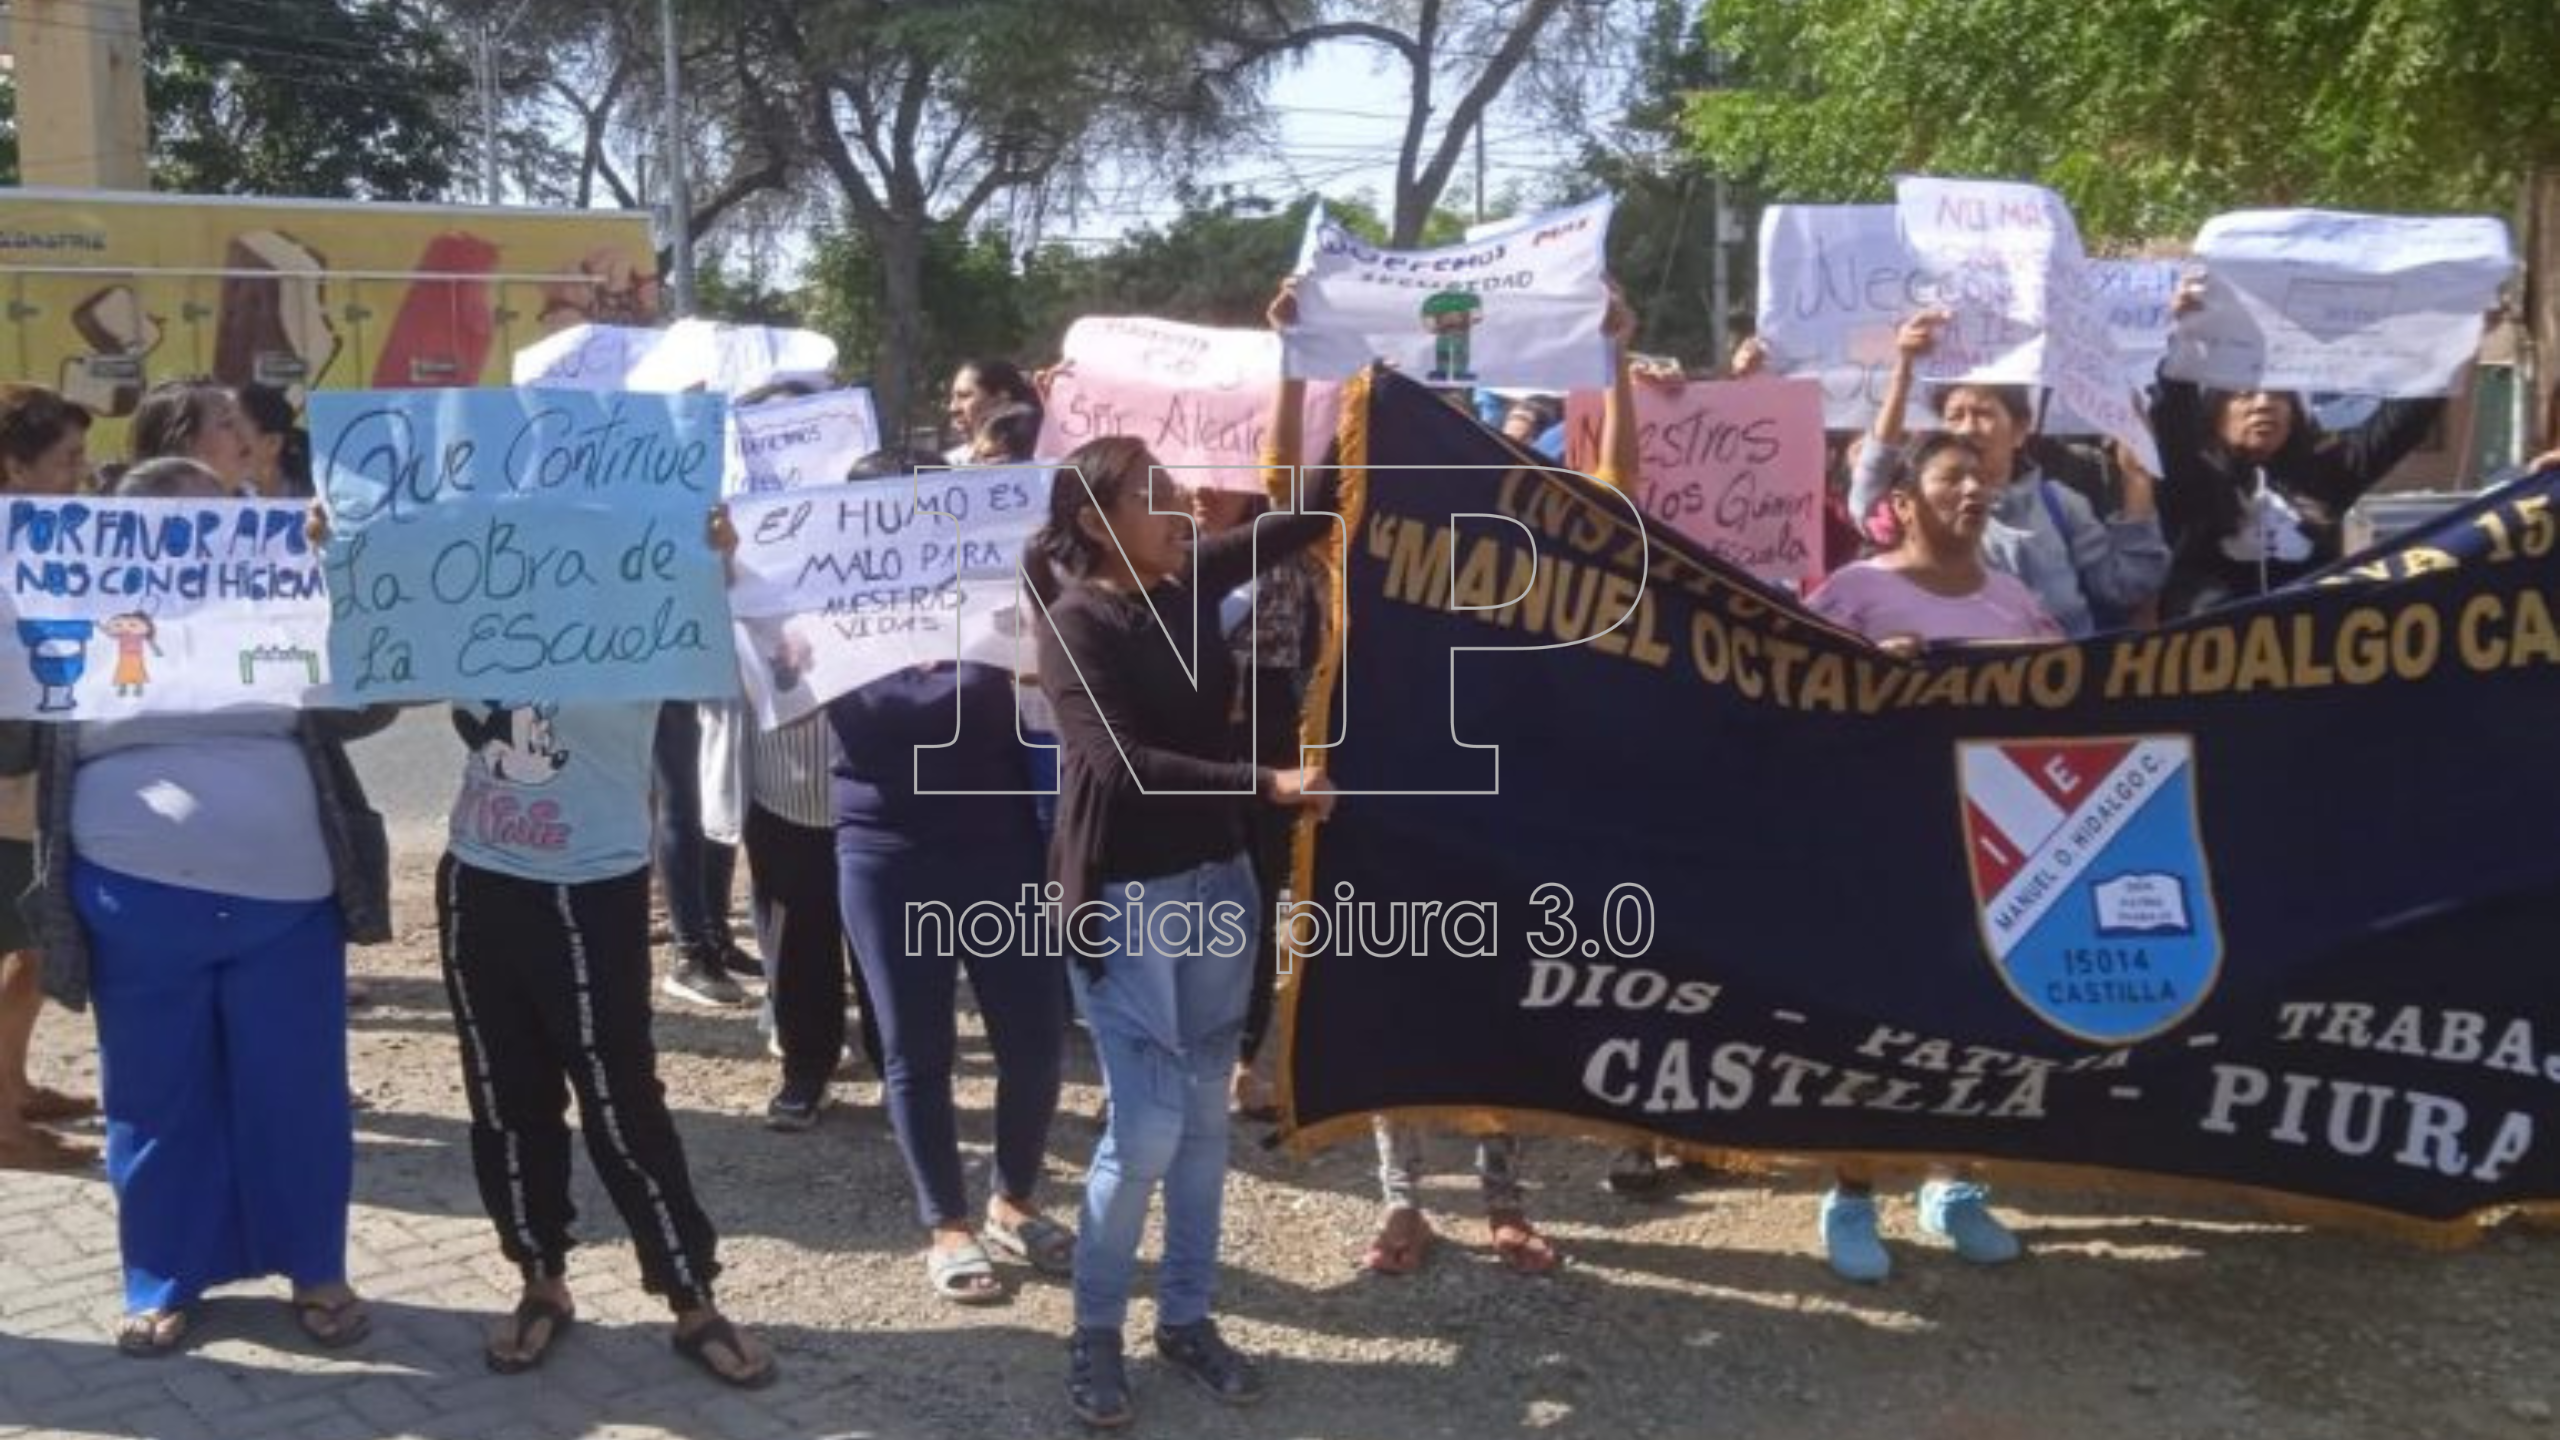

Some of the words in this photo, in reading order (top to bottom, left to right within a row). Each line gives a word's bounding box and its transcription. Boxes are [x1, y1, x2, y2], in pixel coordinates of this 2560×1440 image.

[326, 408, 477, 524] Que
[8, 500, 91, 555] POR
[95, 508, 221, 562] FAVOR
[838, 485, 968, 537] HUMO
[620, 518, 679, 583] de
[795, 546, 902, 588] MALO
[919, 539, 1003, 571] PARA
[15, 560, 91, 598] NOS
[1690, 608, 2084, 714] OCTAVIANO
[2104, 602, 2441, 699] HIDALGO
[2043, 754, 2082, 794] E
[1994, 868, 2056, 933] MANUEL
[2072, 770, 2146, 848] HIDALGO
[1519, 959, 1722, 1014] DIOS
[2063, 948, 2151, 976] 15014
[2046, 979, 2178, 1005] CASTILLA
[1582, 1038, 2048, 1119] CASTILLA
[2199, 1063, 2534, 1182] PIURA
